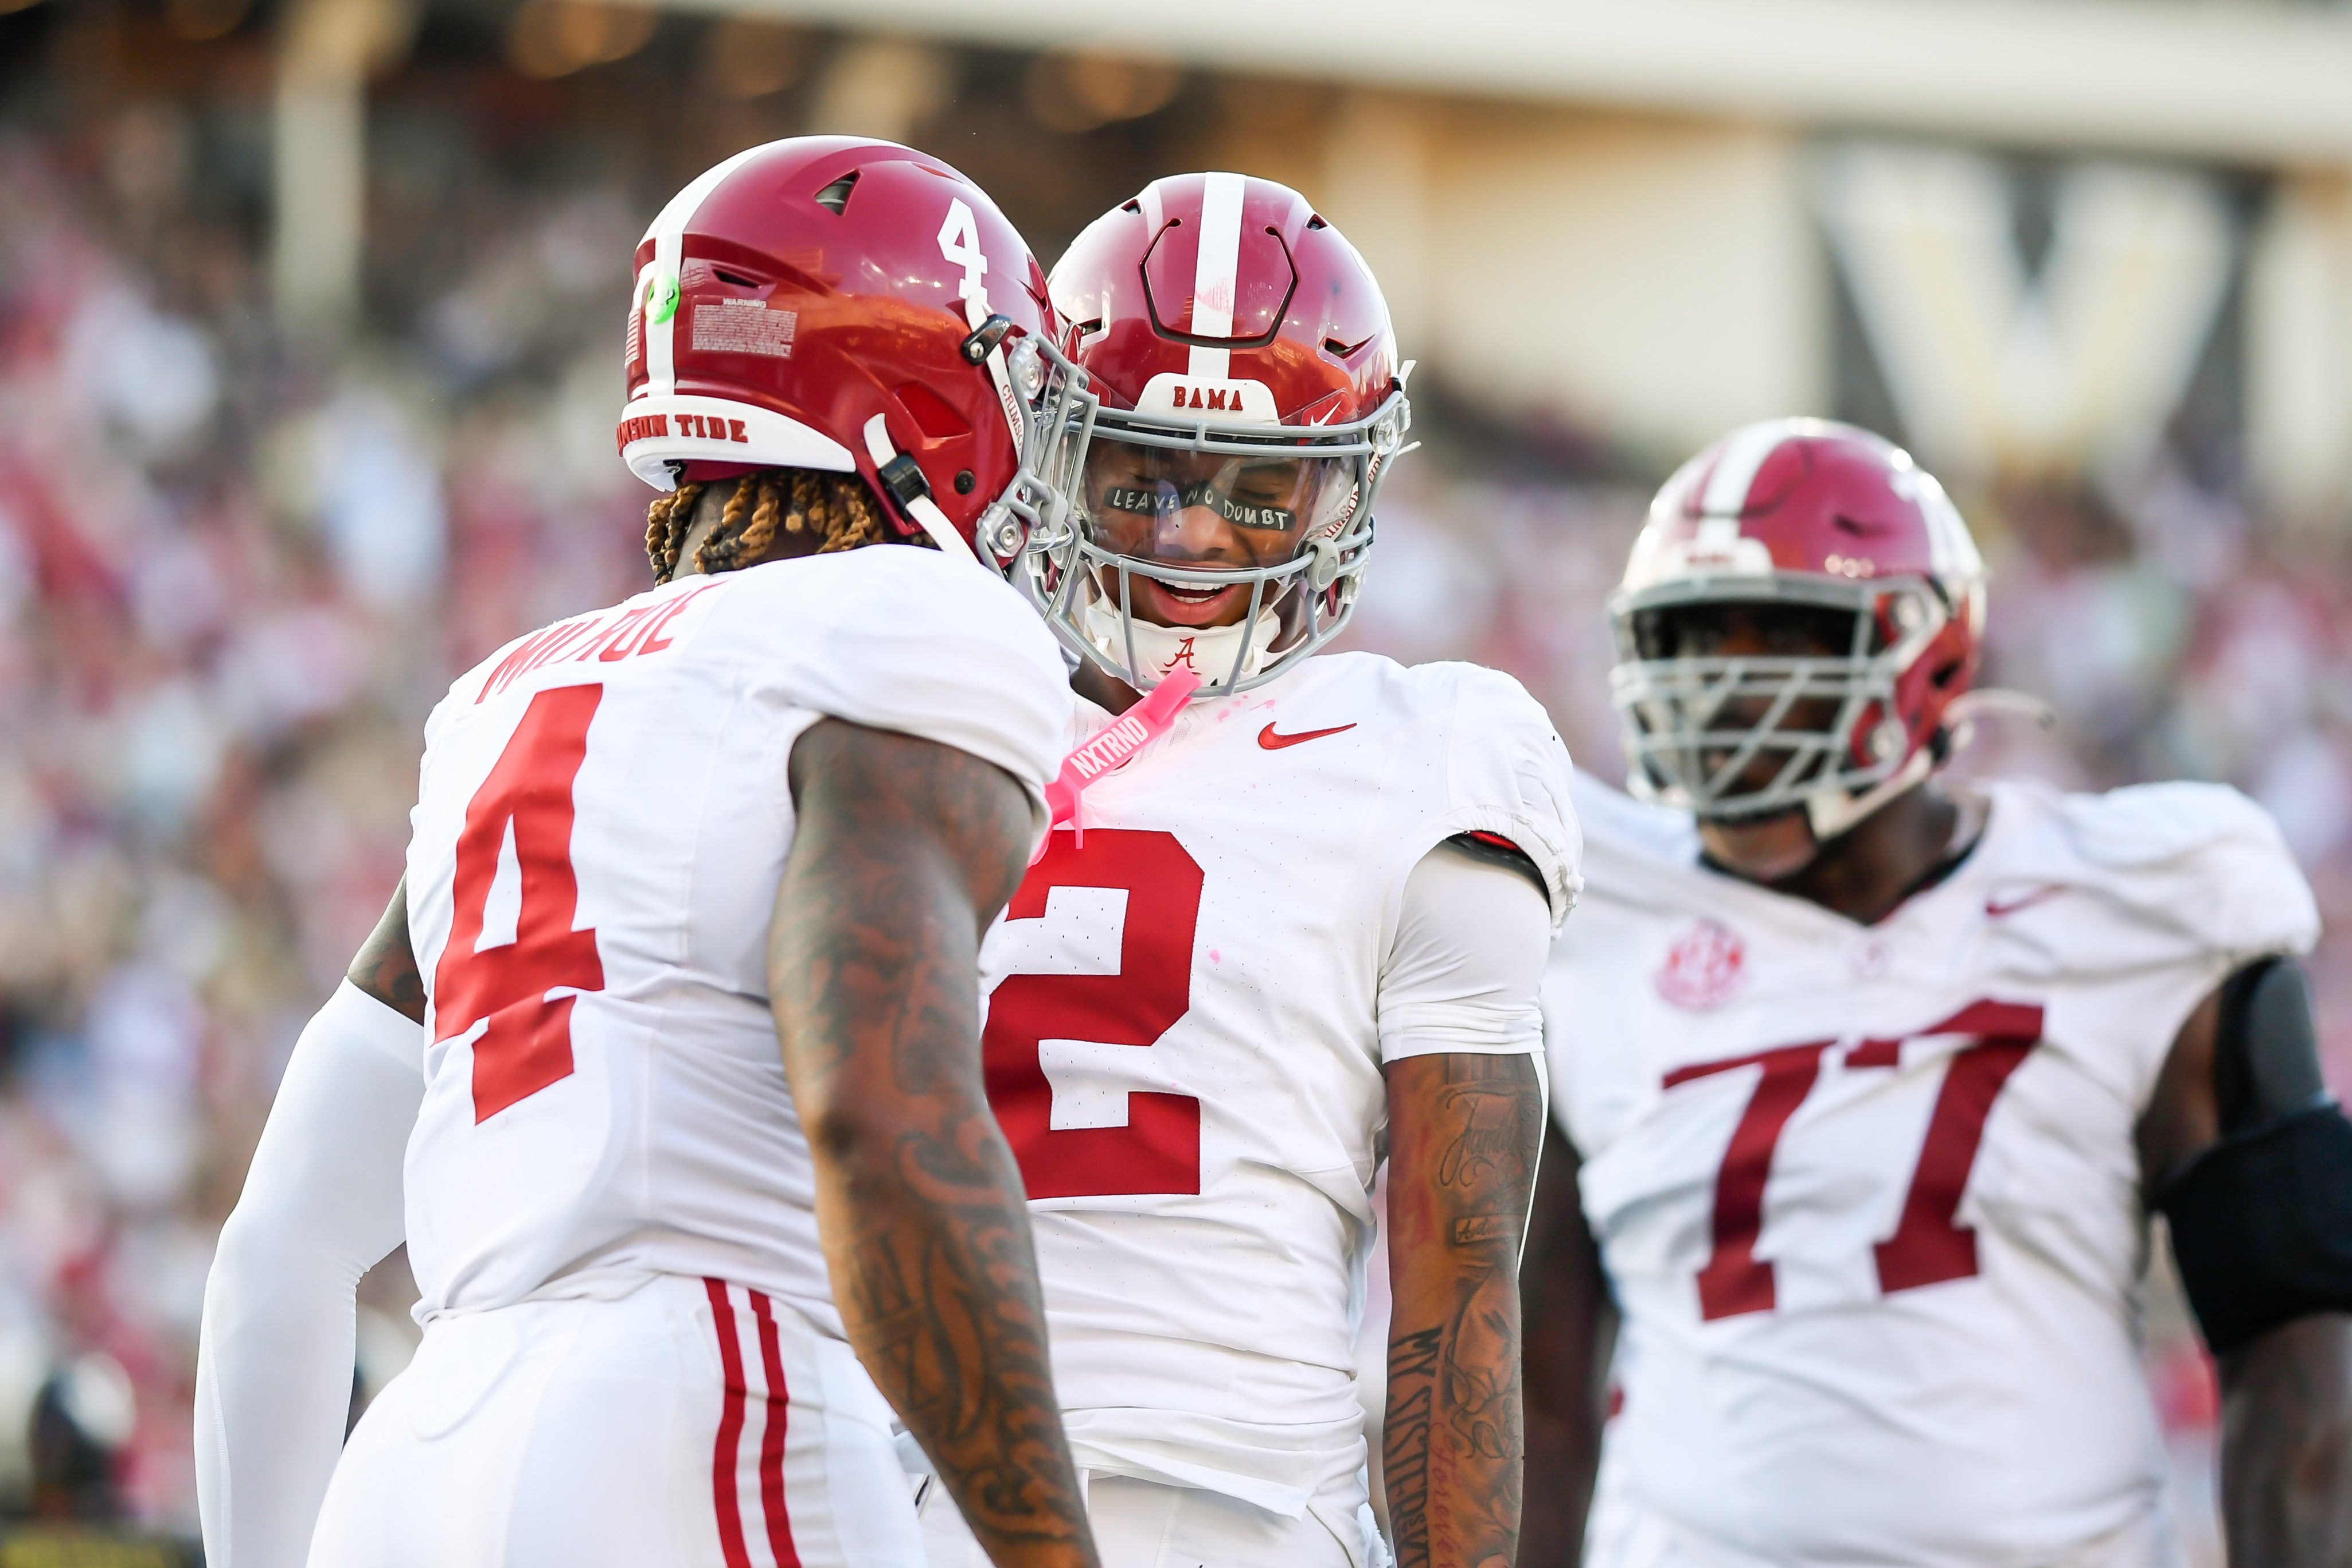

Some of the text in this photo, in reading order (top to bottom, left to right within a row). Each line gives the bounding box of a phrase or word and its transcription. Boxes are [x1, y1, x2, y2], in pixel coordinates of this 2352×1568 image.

[937, 197, 988, 304] 4
[674, 414, 749, 443] TIDE
[1002, 384, 1023, 451] CRIMSO
[1173, 386, 1244, 411] BAMA
[1113, 489, 1288, 530] LEAVE NO DOUBT
[1163, 637, 1195, 669] A
[1069, 716, 1148, 779] NXTRND
[431, 682, 604, 1126] 4
[982, 828, 1204, 1201] 2
[1661, 998, 2044, 1323] 77
